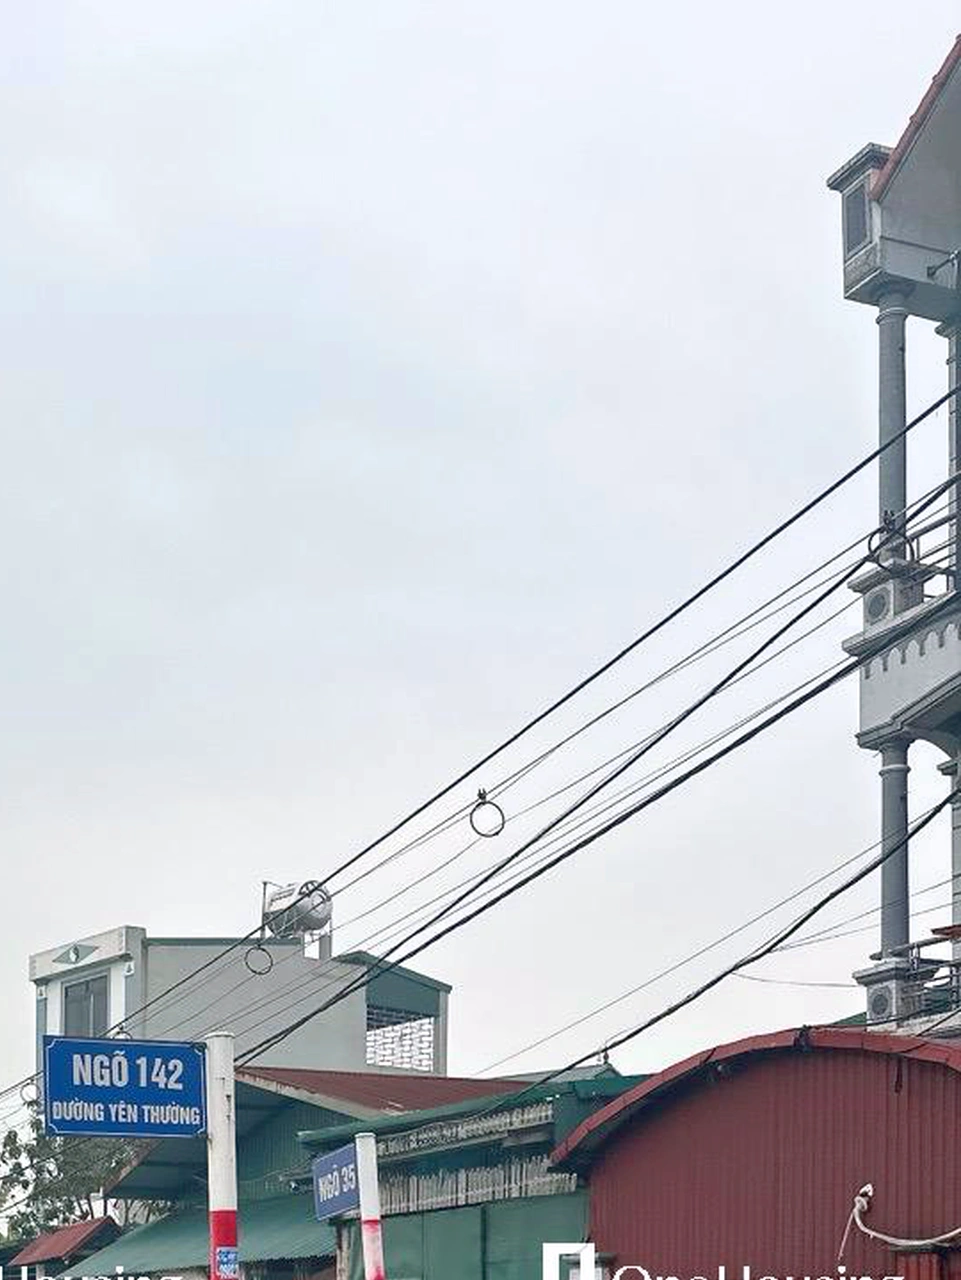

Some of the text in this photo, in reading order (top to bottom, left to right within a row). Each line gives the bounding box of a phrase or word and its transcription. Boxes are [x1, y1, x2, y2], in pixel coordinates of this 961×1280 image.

[72, 1050, 183, 1090] NGÕ 142
[52, 1097, 104, 1121] ĐƯỜNG
[109, 1101, 138, 1123] YÊN
[341, 1163, 356, 1193] 35
